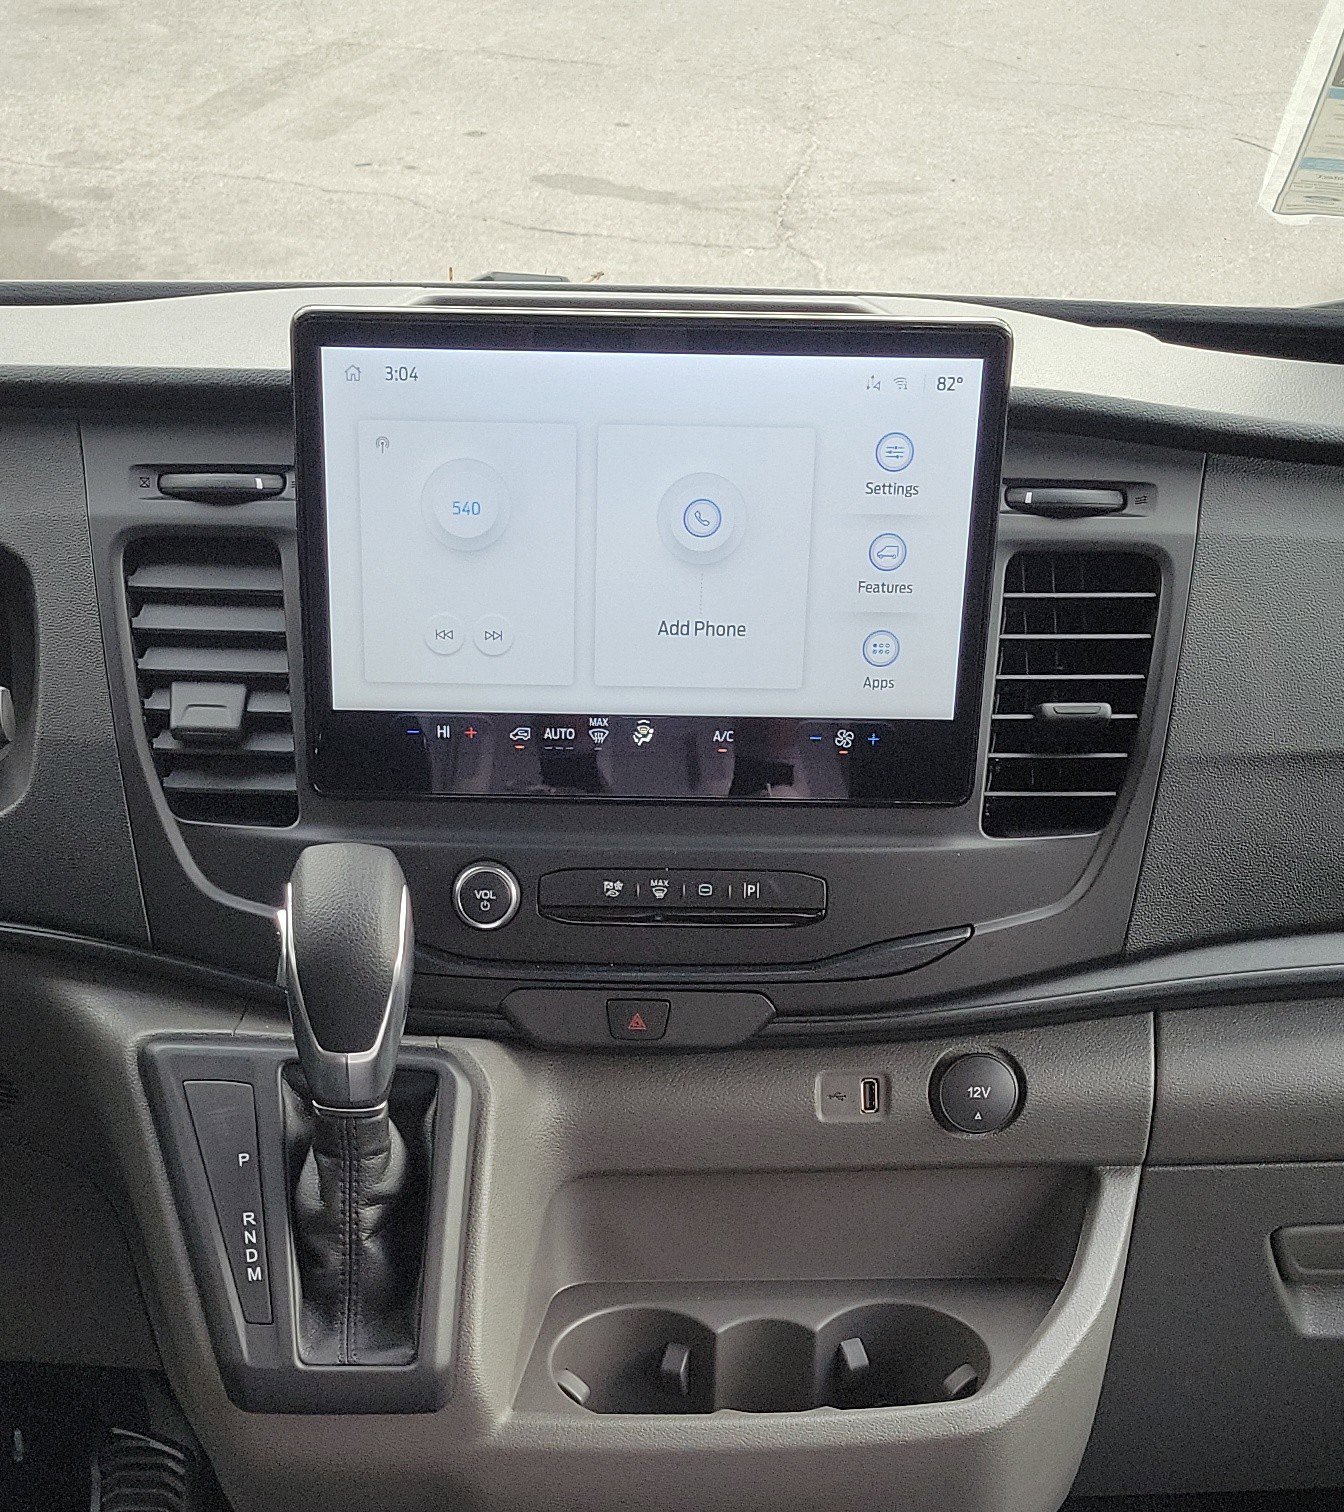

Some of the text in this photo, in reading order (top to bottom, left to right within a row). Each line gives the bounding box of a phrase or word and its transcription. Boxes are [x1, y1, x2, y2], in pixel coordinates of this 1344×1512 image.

[384, 366, 419, 381] 3:04
[865, 482, 920, 497] Settings
[452, 501, 481, 516] 540
[857, 580, 914, 594] Features
[657, 620, 747, 637] Add Phone
[862, 677, 895, 690] Apps
[588, 718, 609, 727] MAX
[436, 725, 450, 739] HI
[543, 727, 576, 741] AUTO
[712, 730, 735, 744] A/C
[650, 879, 669, 888] MAX
[474, 890, 496, 900] VOL
[967, 1086, 992, 1099] 12V
[238, 1153, 250, 1167] P
